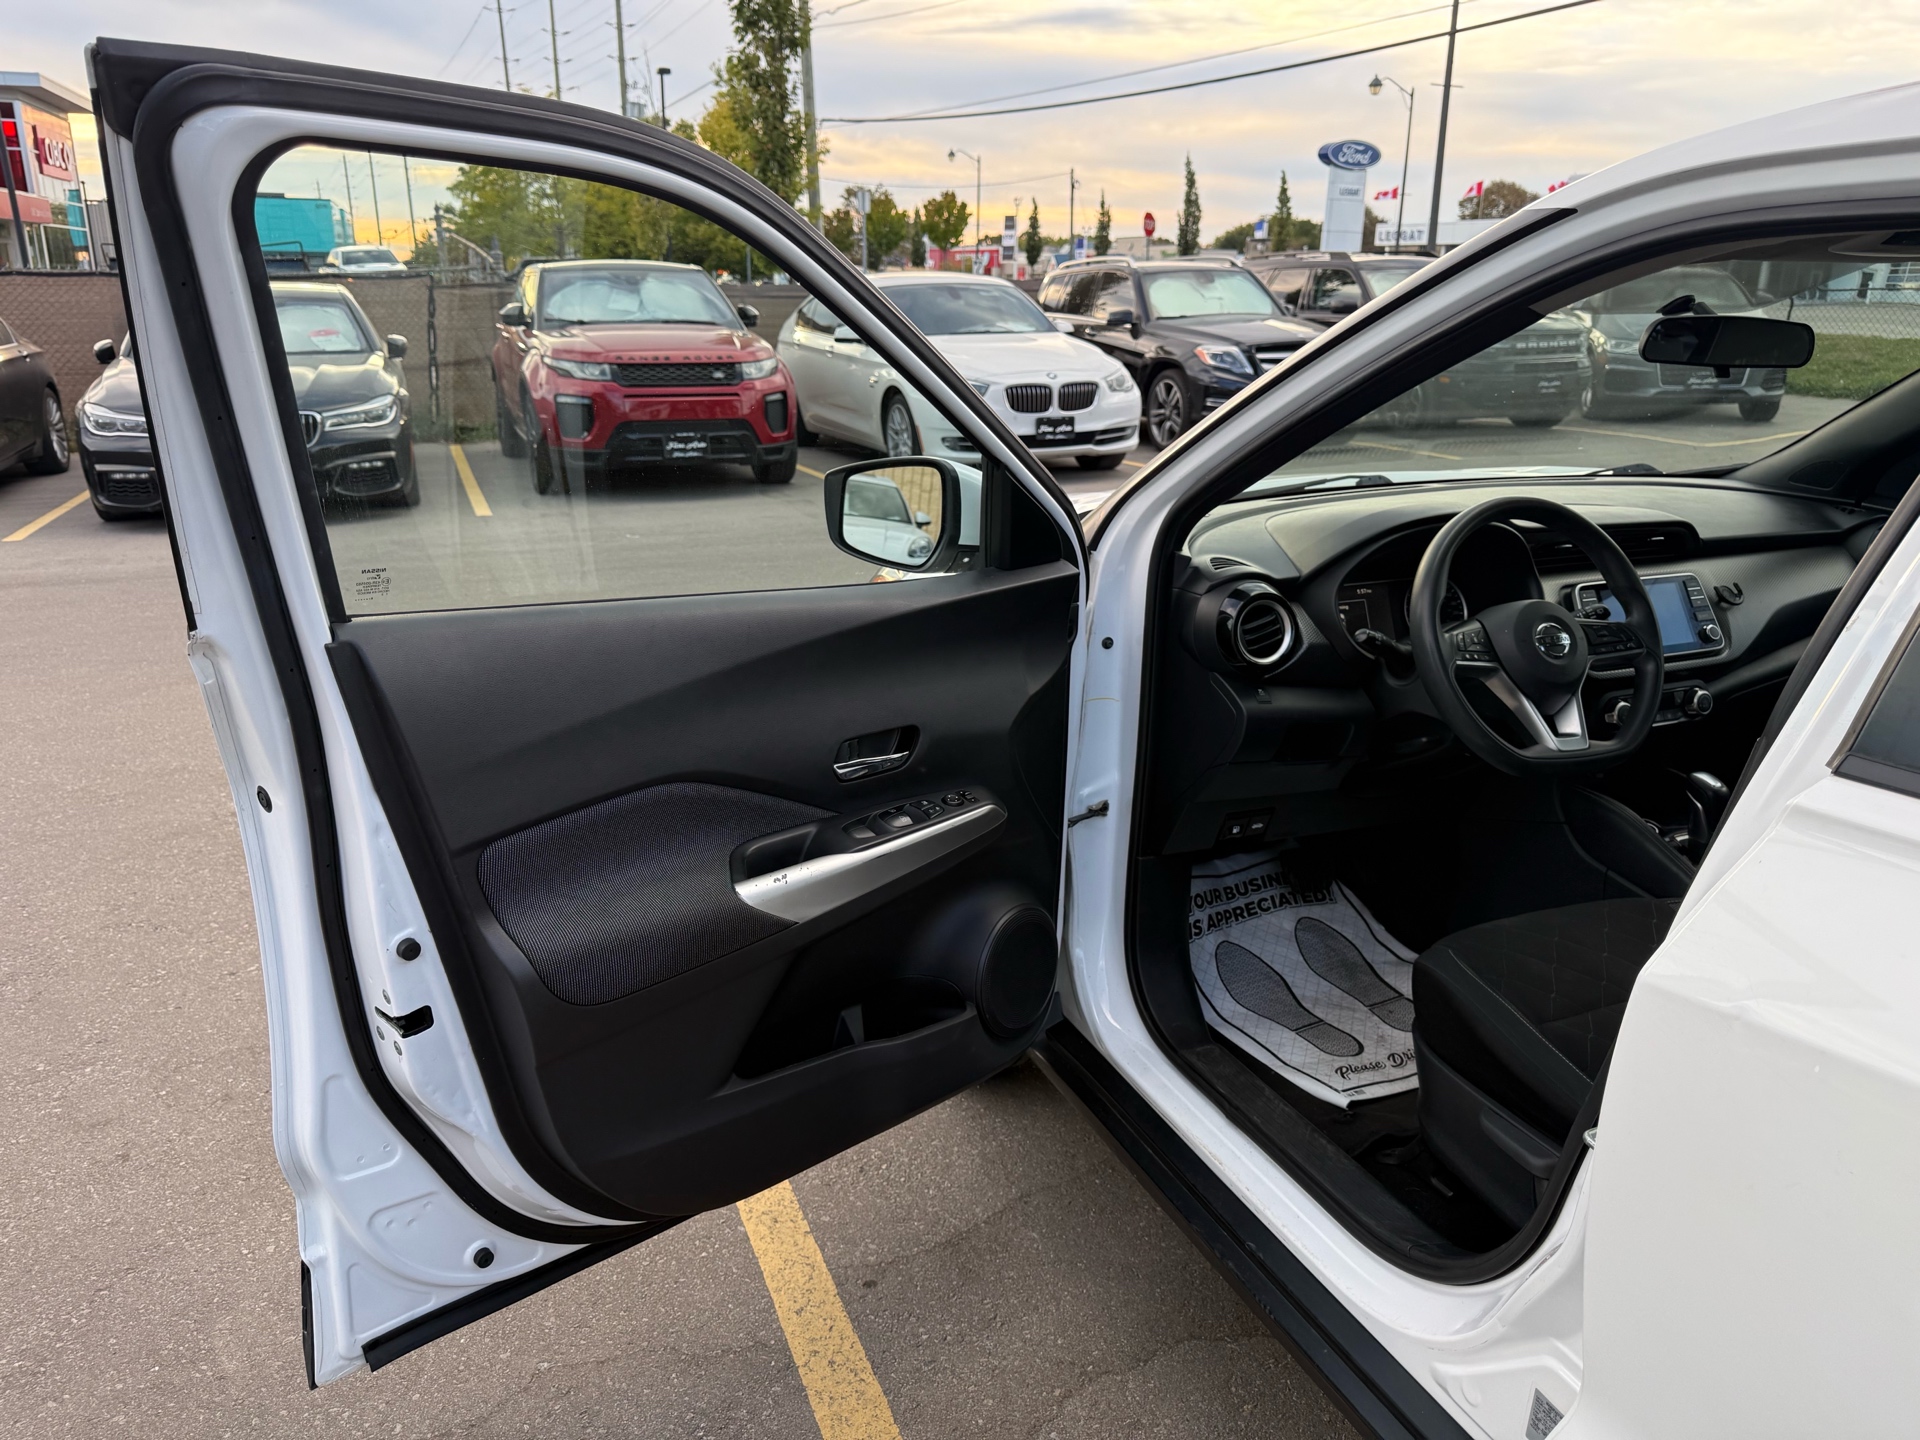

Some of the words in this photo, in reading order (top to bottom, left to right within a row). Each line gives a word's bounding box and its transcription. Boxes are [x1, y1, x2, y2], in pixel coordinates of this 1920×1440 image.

[1338, 143, 1373, 164] Ford
[1224, 872, 1292, 901] BUSIN
[1207, 886, 1336, 933] APPRECIATED!
[1335, 1061, 1386, 1080] Please
[1387, 1048, 1416, 1068] Dri
